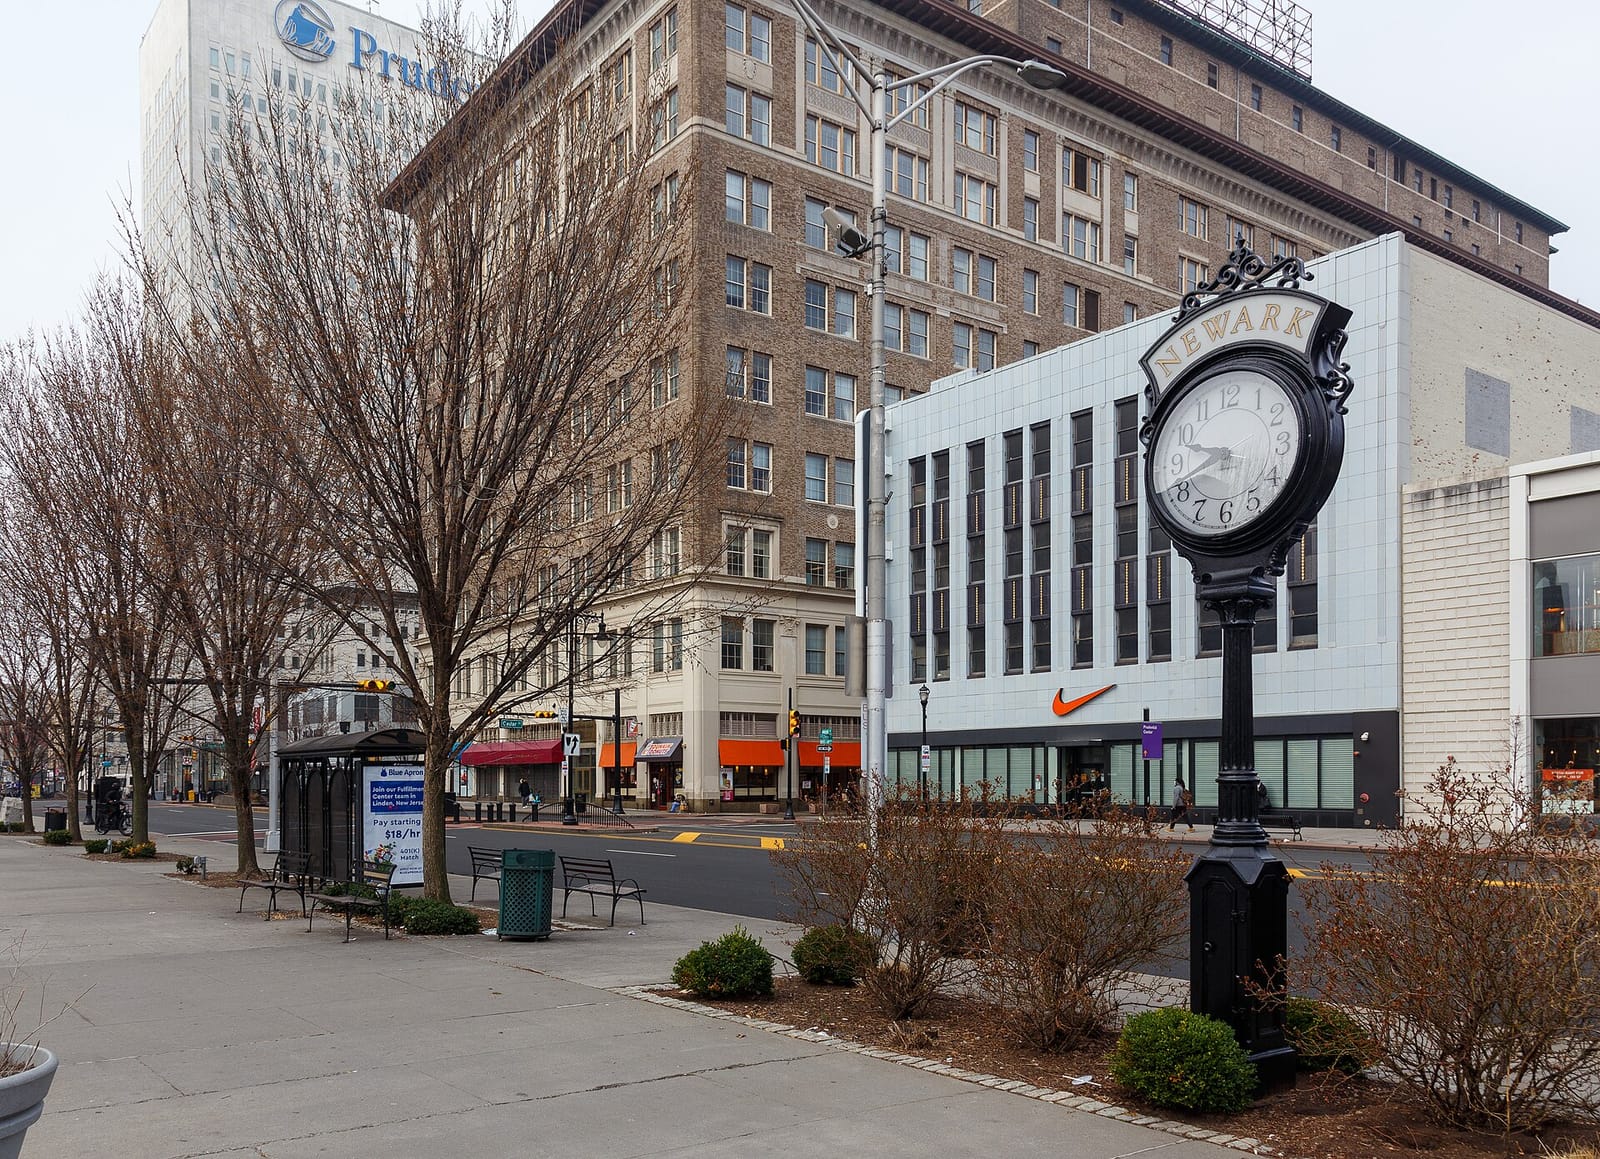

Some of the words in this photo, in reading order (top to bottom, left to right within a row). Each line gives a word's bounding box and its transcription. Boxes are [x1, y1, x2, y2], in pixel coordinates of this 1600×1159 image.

[1155, 303, 1313, 377] NEWARK
[1220, 384, 1241, 410] 12
[1255, 388, 1262, 411] 1
[1197, 399, 1209, 422] 11
[1270, 402, 1285, 427] 2
[1178, 423, 1194, 447] 10
[1275, 431, 1291, 456] 3
[1171, 453, 1184, 476] 9
[1264, 464, 1282, 488] 4
[1177, 480, 1190, 503] 8
[1246, 487, 1261, 512] 5
[1192, 498, 1207, 522] 7
[1219, 500, 1233, 524] 6
[388, 768, 403, 776] Blue
[404, 769, 424, 777] Apron
[373, 819, 388, 827] Pay
[390, 818, 421, 827] starting
[385, 828, 421, 840] $18/hr
